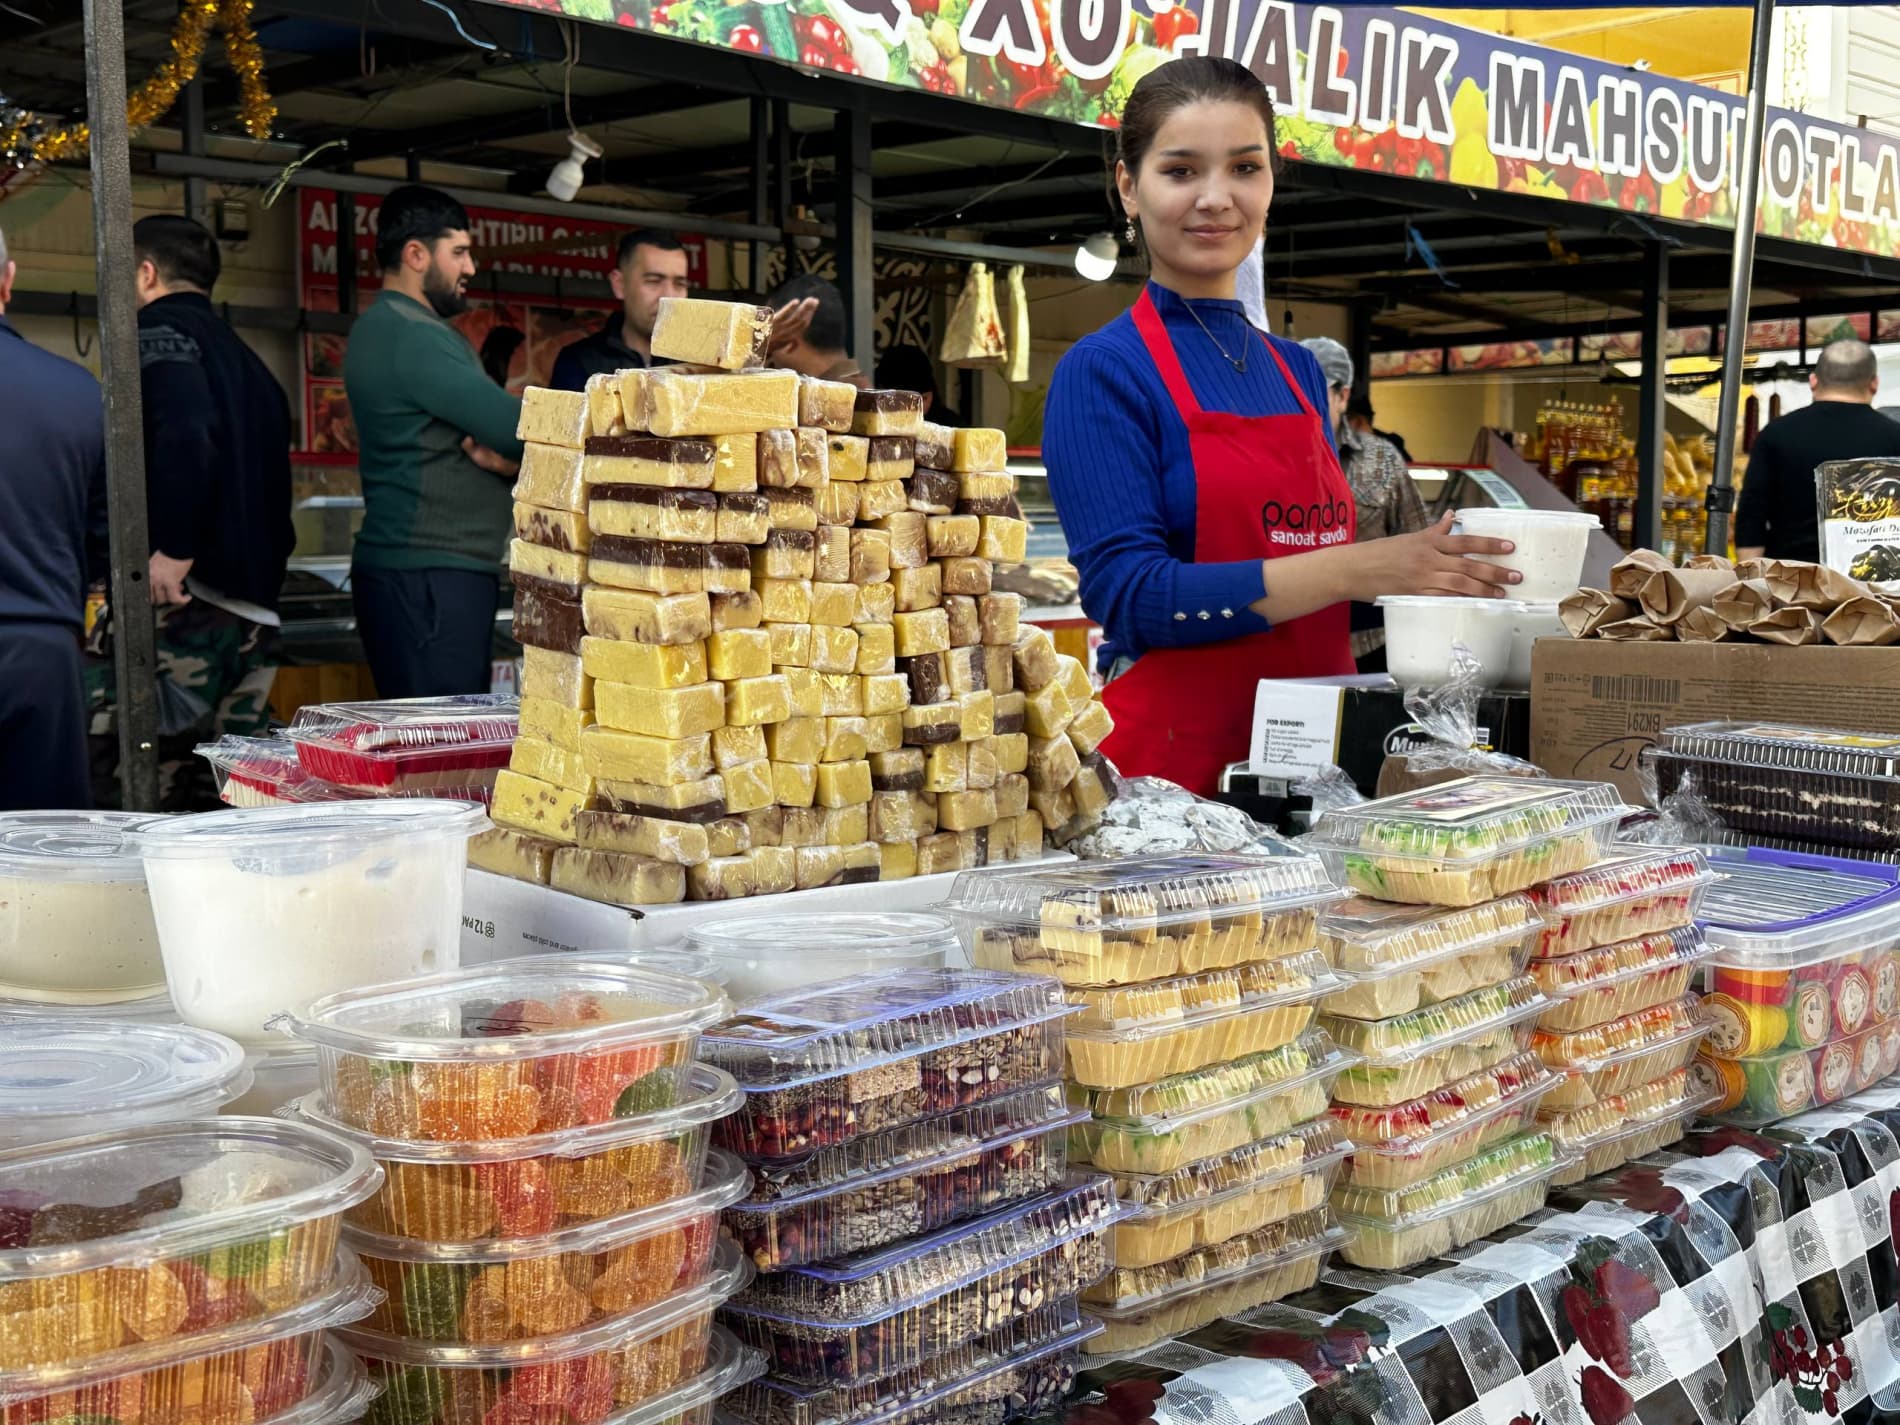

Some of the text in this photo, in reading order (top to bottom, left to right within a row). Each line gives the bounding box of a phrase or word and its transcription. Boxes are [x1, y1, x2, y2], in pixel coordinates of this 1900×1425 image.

[1488, 51, 1900, 224] MAHSUOTLA
[1262, 494, 1348, 540] panda
[1270, 529, 1316, 546] sanoat
[1627, 713, 1661, 733] BK291
[474, 919, 484, 935] 12
